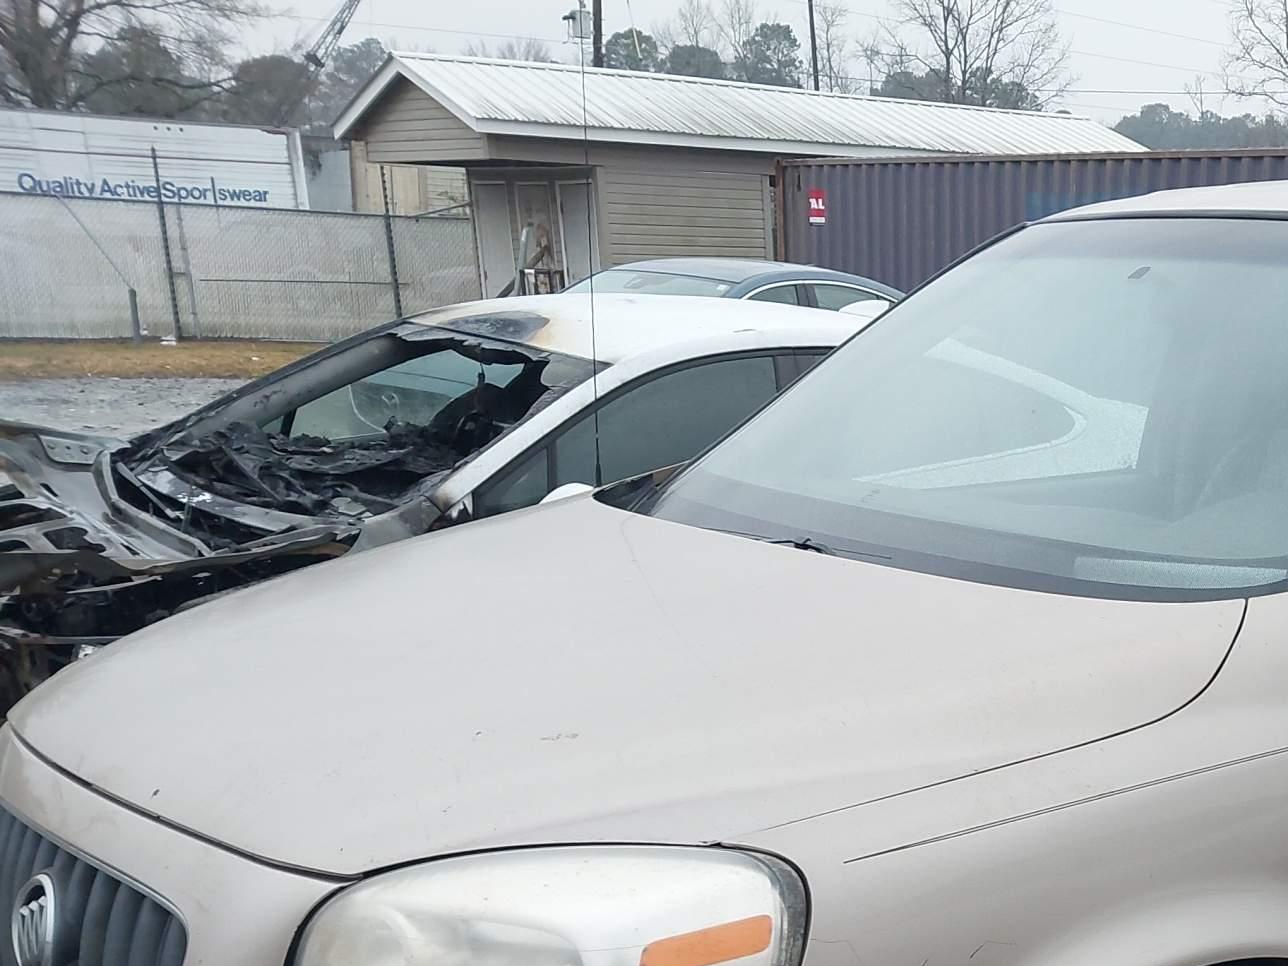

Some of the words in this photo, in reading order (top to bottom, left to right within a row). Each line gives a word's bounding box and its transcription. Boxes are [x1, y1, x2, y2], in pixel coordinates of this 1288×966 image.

[17, 172, 96, 197] Quality
[99, 177, 159, 199] Active
[161, 181, 269, 202] Sporswear
